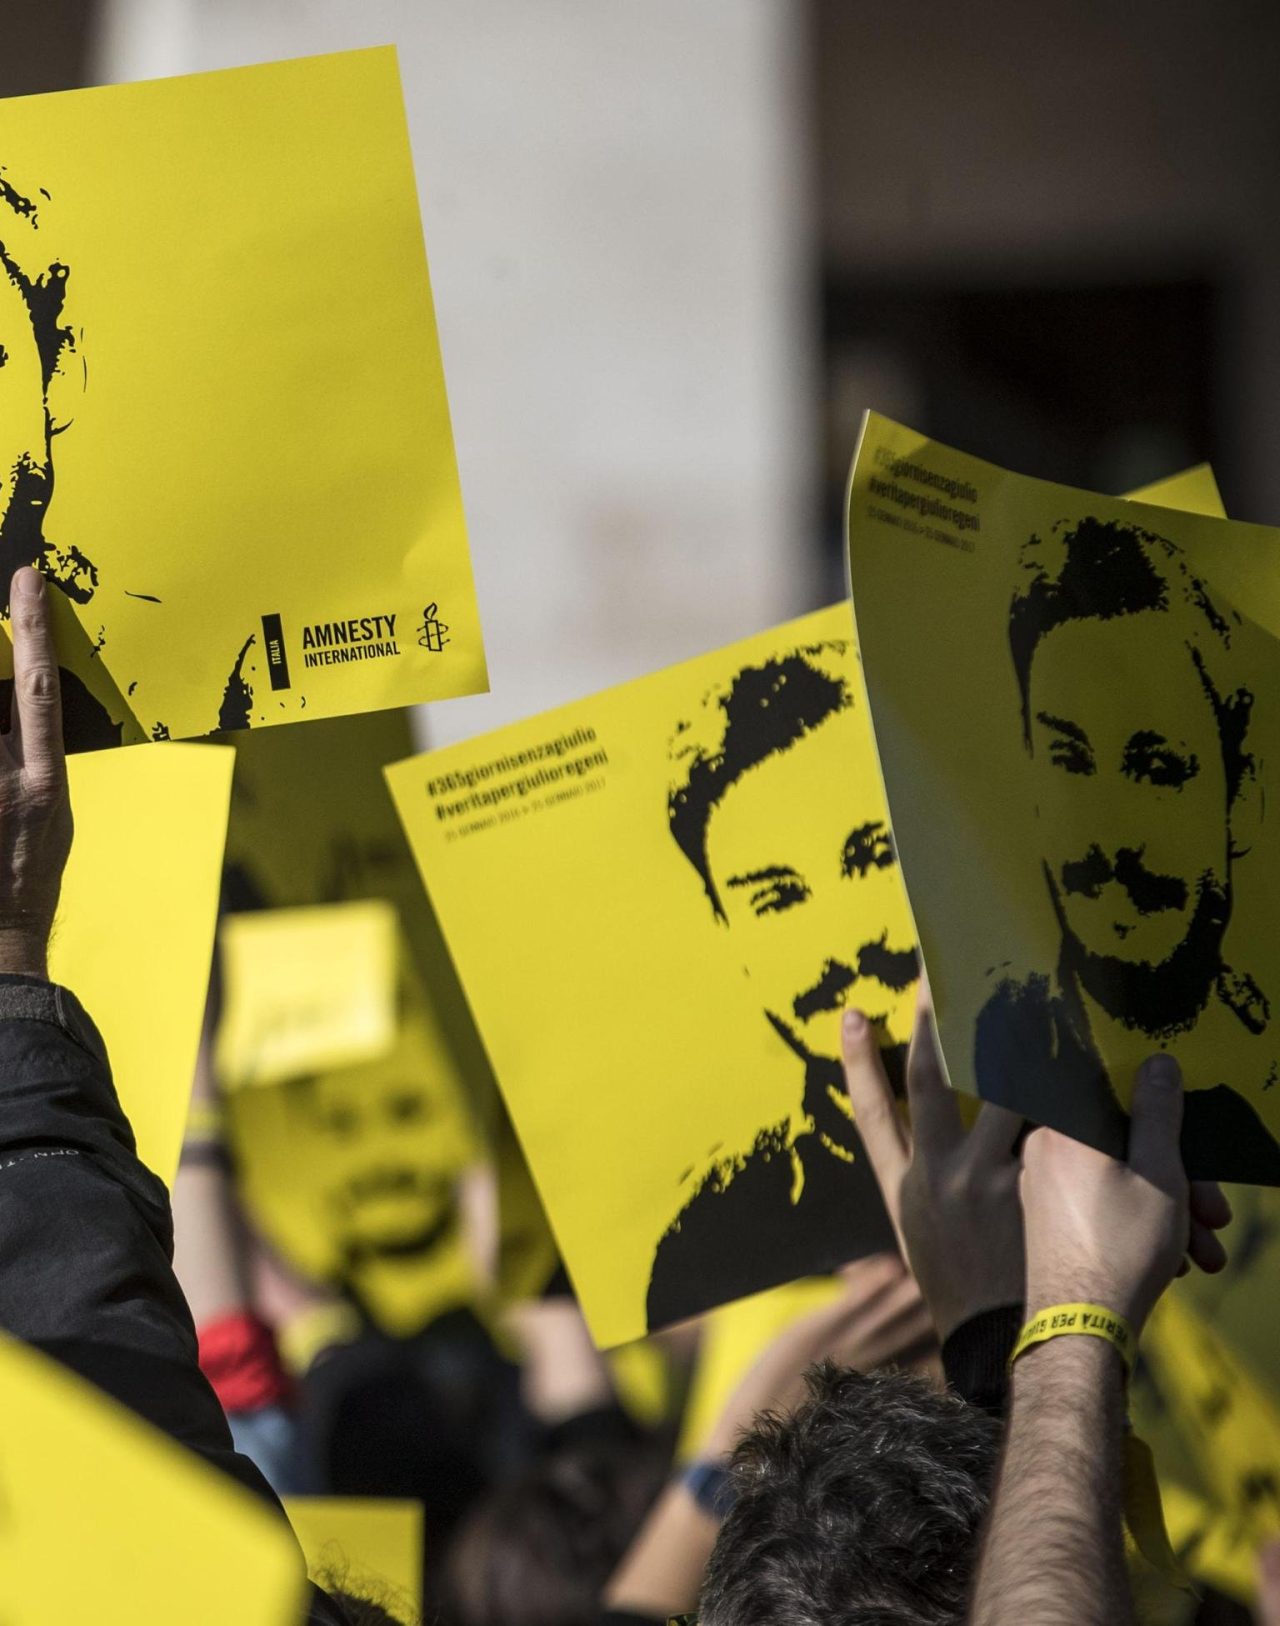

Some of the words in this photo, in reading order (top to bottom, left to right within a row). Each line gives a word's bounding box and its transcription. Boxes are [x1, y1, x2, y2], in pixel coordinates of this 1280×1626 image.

[874, 447, 978, 504] giornisenzagiulio
[303, 614, 397, 650] AMNESTY
[271, 639, 283, 665] ITALIA
[304, 641, 401, 668] INTERNATIONAL
[427, 726, 597, 797] #365giornisenzagiulio
[435, 746, 609, 821] #veritapergiulioregeni
[1051, 1313, 1078, 1329] PER
